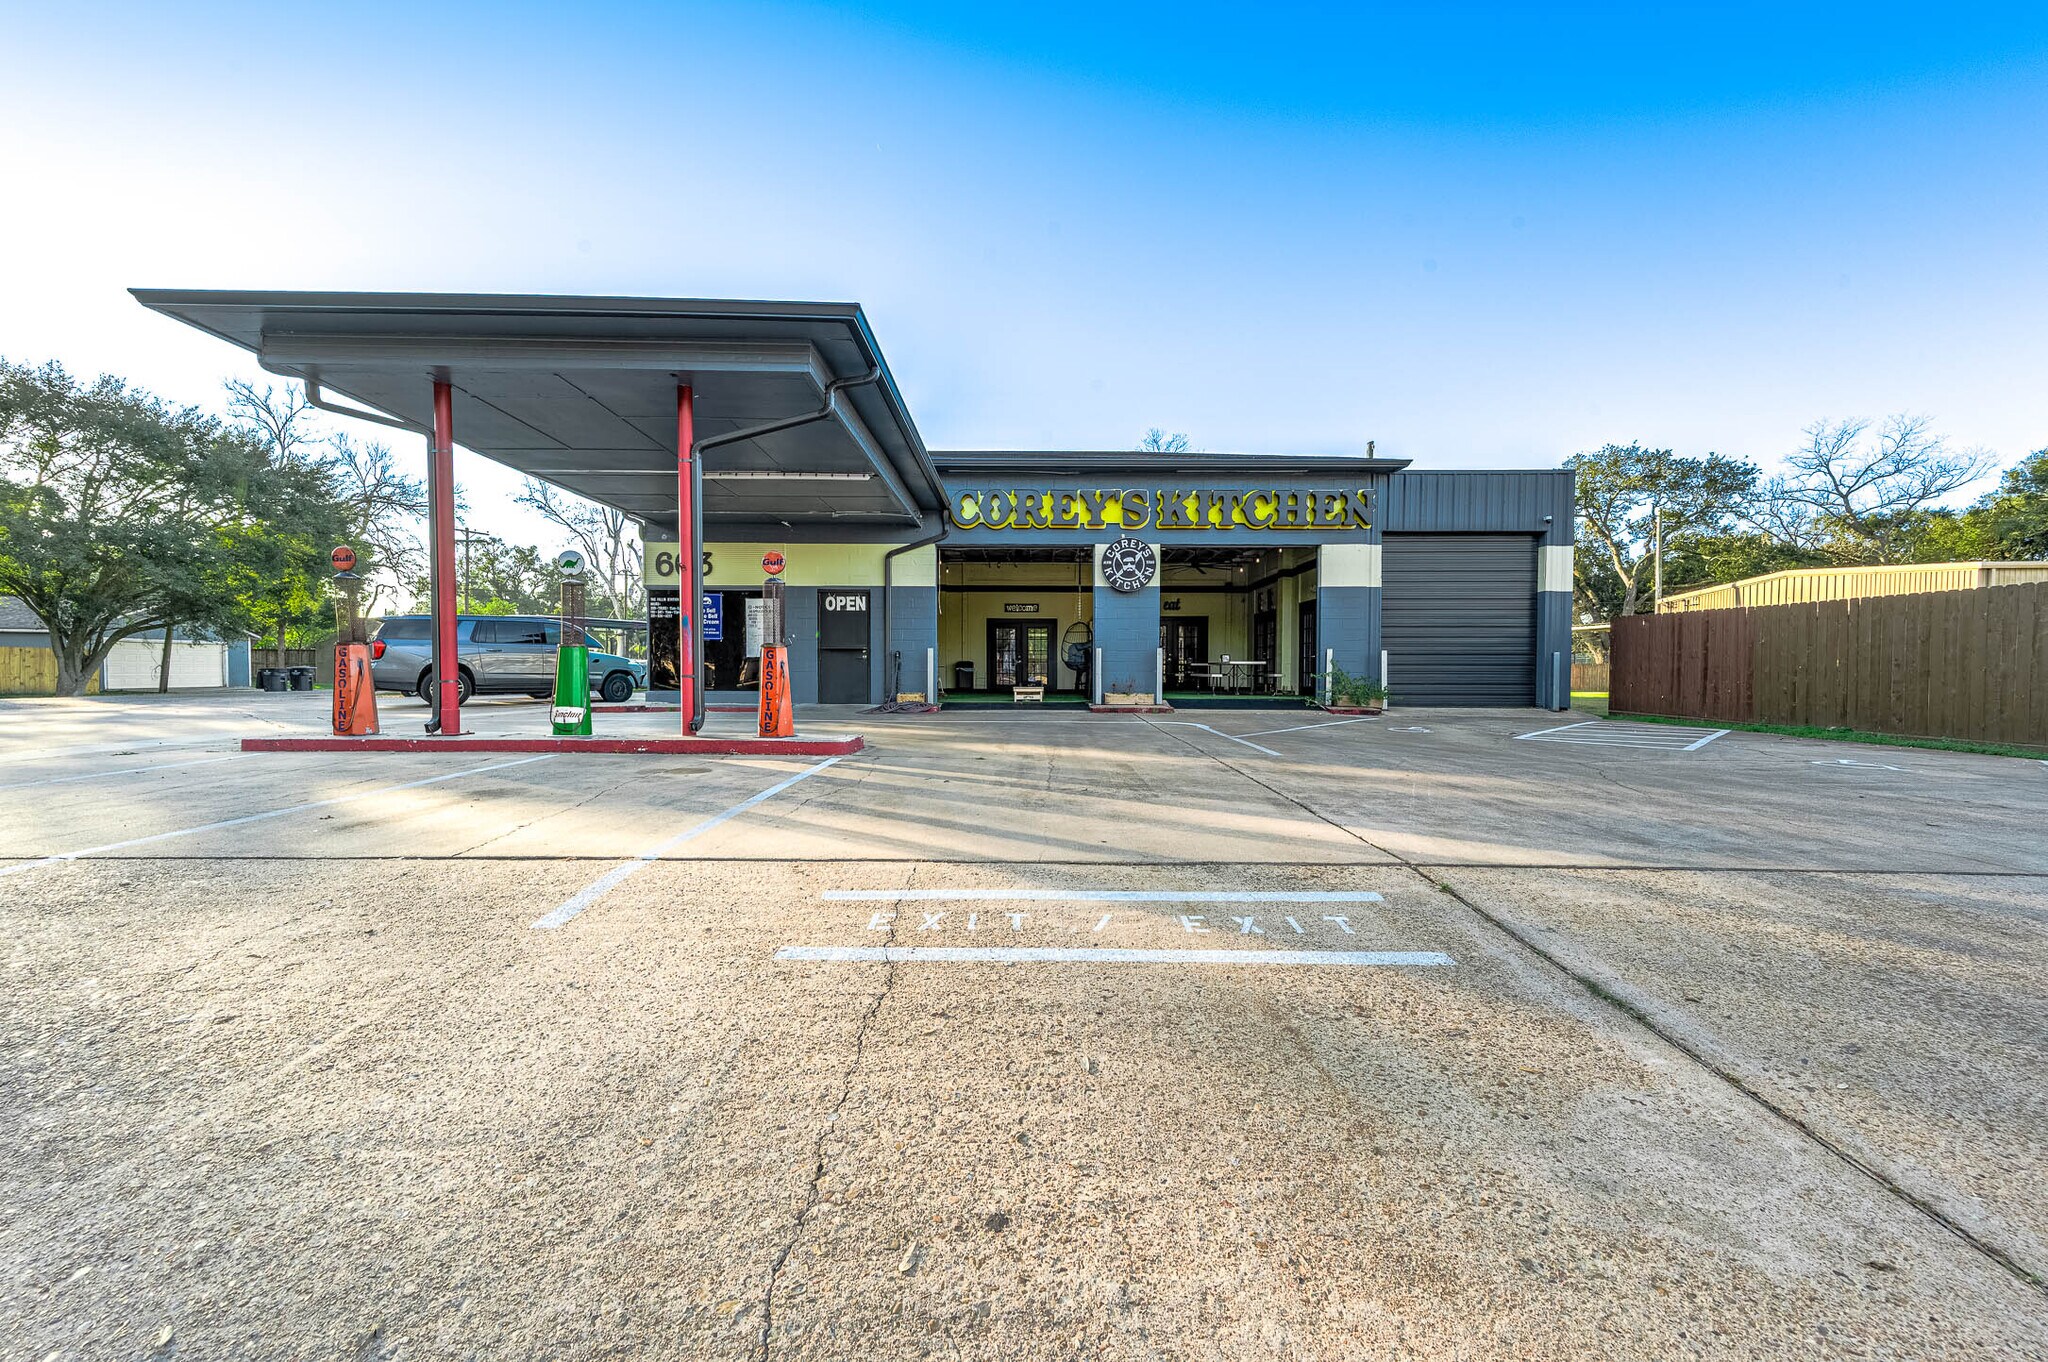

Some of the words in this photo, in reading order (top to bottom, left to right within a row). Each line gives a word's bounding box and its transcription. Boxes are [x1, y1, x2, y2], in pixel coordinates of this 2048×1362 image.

[950, 488, 1152, 529] COREY'S
[1155, 488, 1377, 529] KITCHEN
[332, 554, 354, 562] Gulf
[1106, 539, 1152, 558] COREY'S
[655, 551, 713, 577] 63
[762, 558, 785, 567] Gulf
[1104, 567, 1154, 590] KITCHEN
[825, 596, 866, 611] OPEN
[1006, 604, 1038, 612] welcome
[1163, 598, 1181, 610] eat
[338, 647, 348, 731] GASOLINE
[764, 649, 775, 733] GASOLINE
[865, 912, 1030, 932] EXIT
[1179, 914, 1357, 935] EXIT
